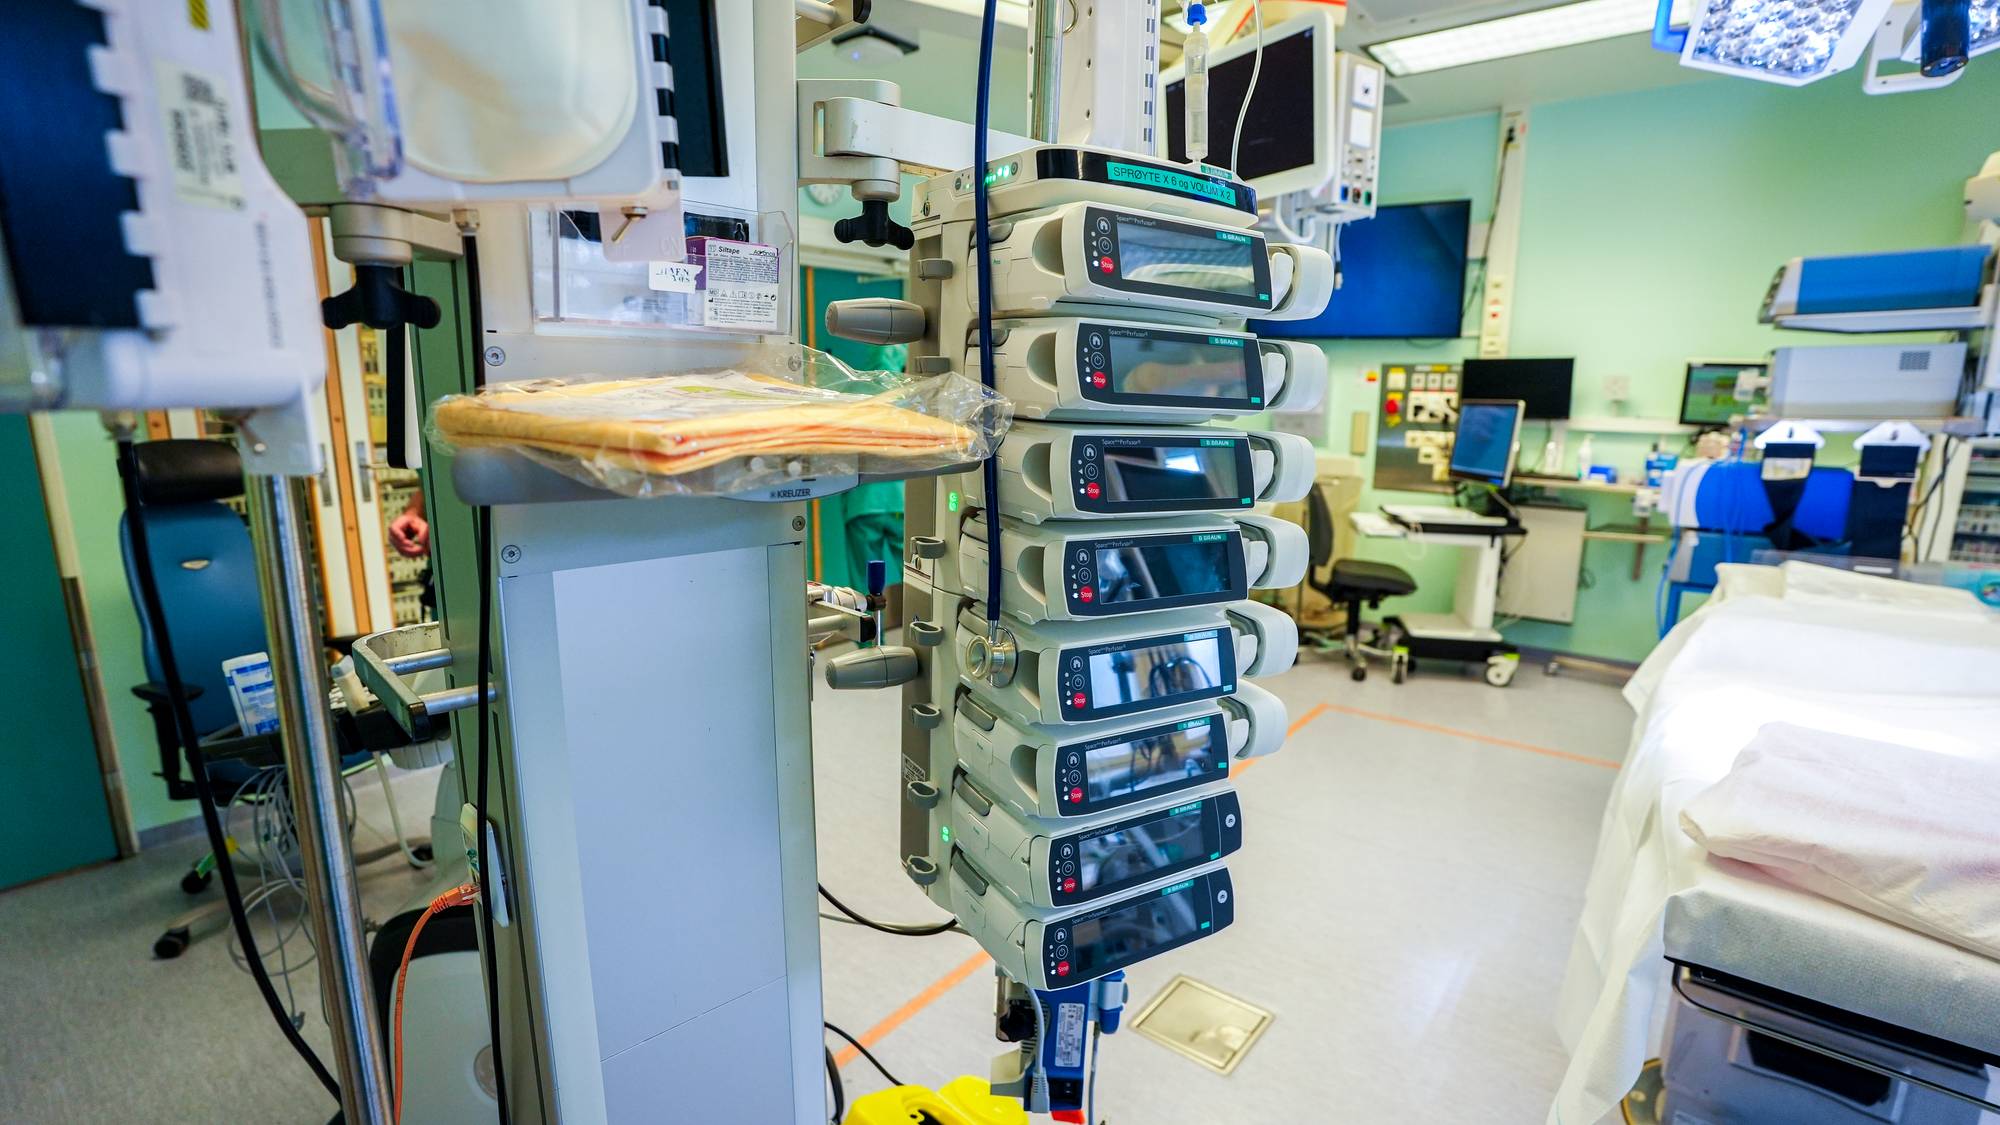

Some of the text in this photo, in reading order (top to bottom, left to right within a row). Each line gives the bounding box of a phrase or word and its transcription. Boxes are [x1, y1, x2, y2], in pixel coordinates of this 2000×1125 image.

[1113, 167, 1160, 183] SPRØYTE
[1163, 176, 1169, 184] X
[1171, 177, 1177, 186] 6
[1179, 180, 1189, 190] og
[1190, 180, 1219, 197] VOLUM
[1220, 190, 1226, 198] X
[1226, 191, 1231, 200] 2
[718, 246, 740, 255] Siltape
[1101, 259, 1114, 270] Stop
[1093, 376, 1106, 385] Stop
[777, 488, 811, 498] KREUZER
[1087, 486, 1100, 495] Stop
[1080, 591, 1093, 599] Stop
